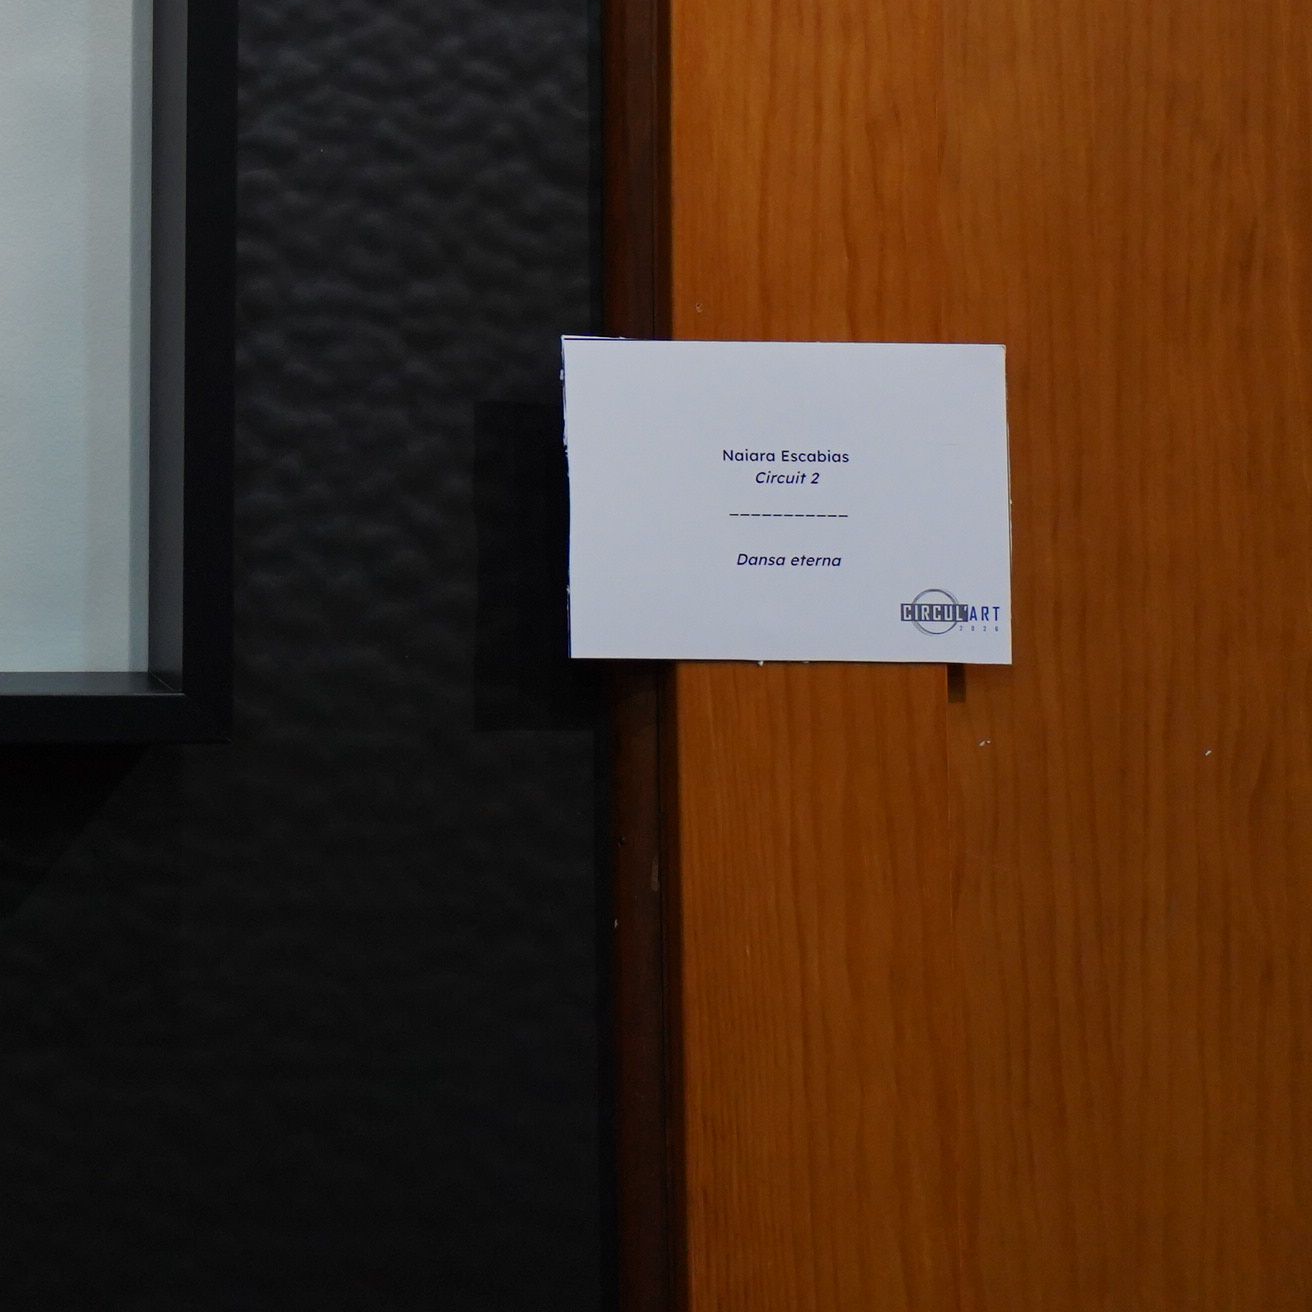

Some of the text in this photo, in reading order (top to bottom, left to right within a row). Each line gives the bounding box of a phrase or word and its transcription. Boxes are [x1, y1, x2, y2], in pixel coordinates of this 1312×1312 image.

[722, 449, 850, 463] Naiara Escabias
[755, 471, 820, 485] Circuit 2
[736, 552, 842, 568] Dansa eterna
